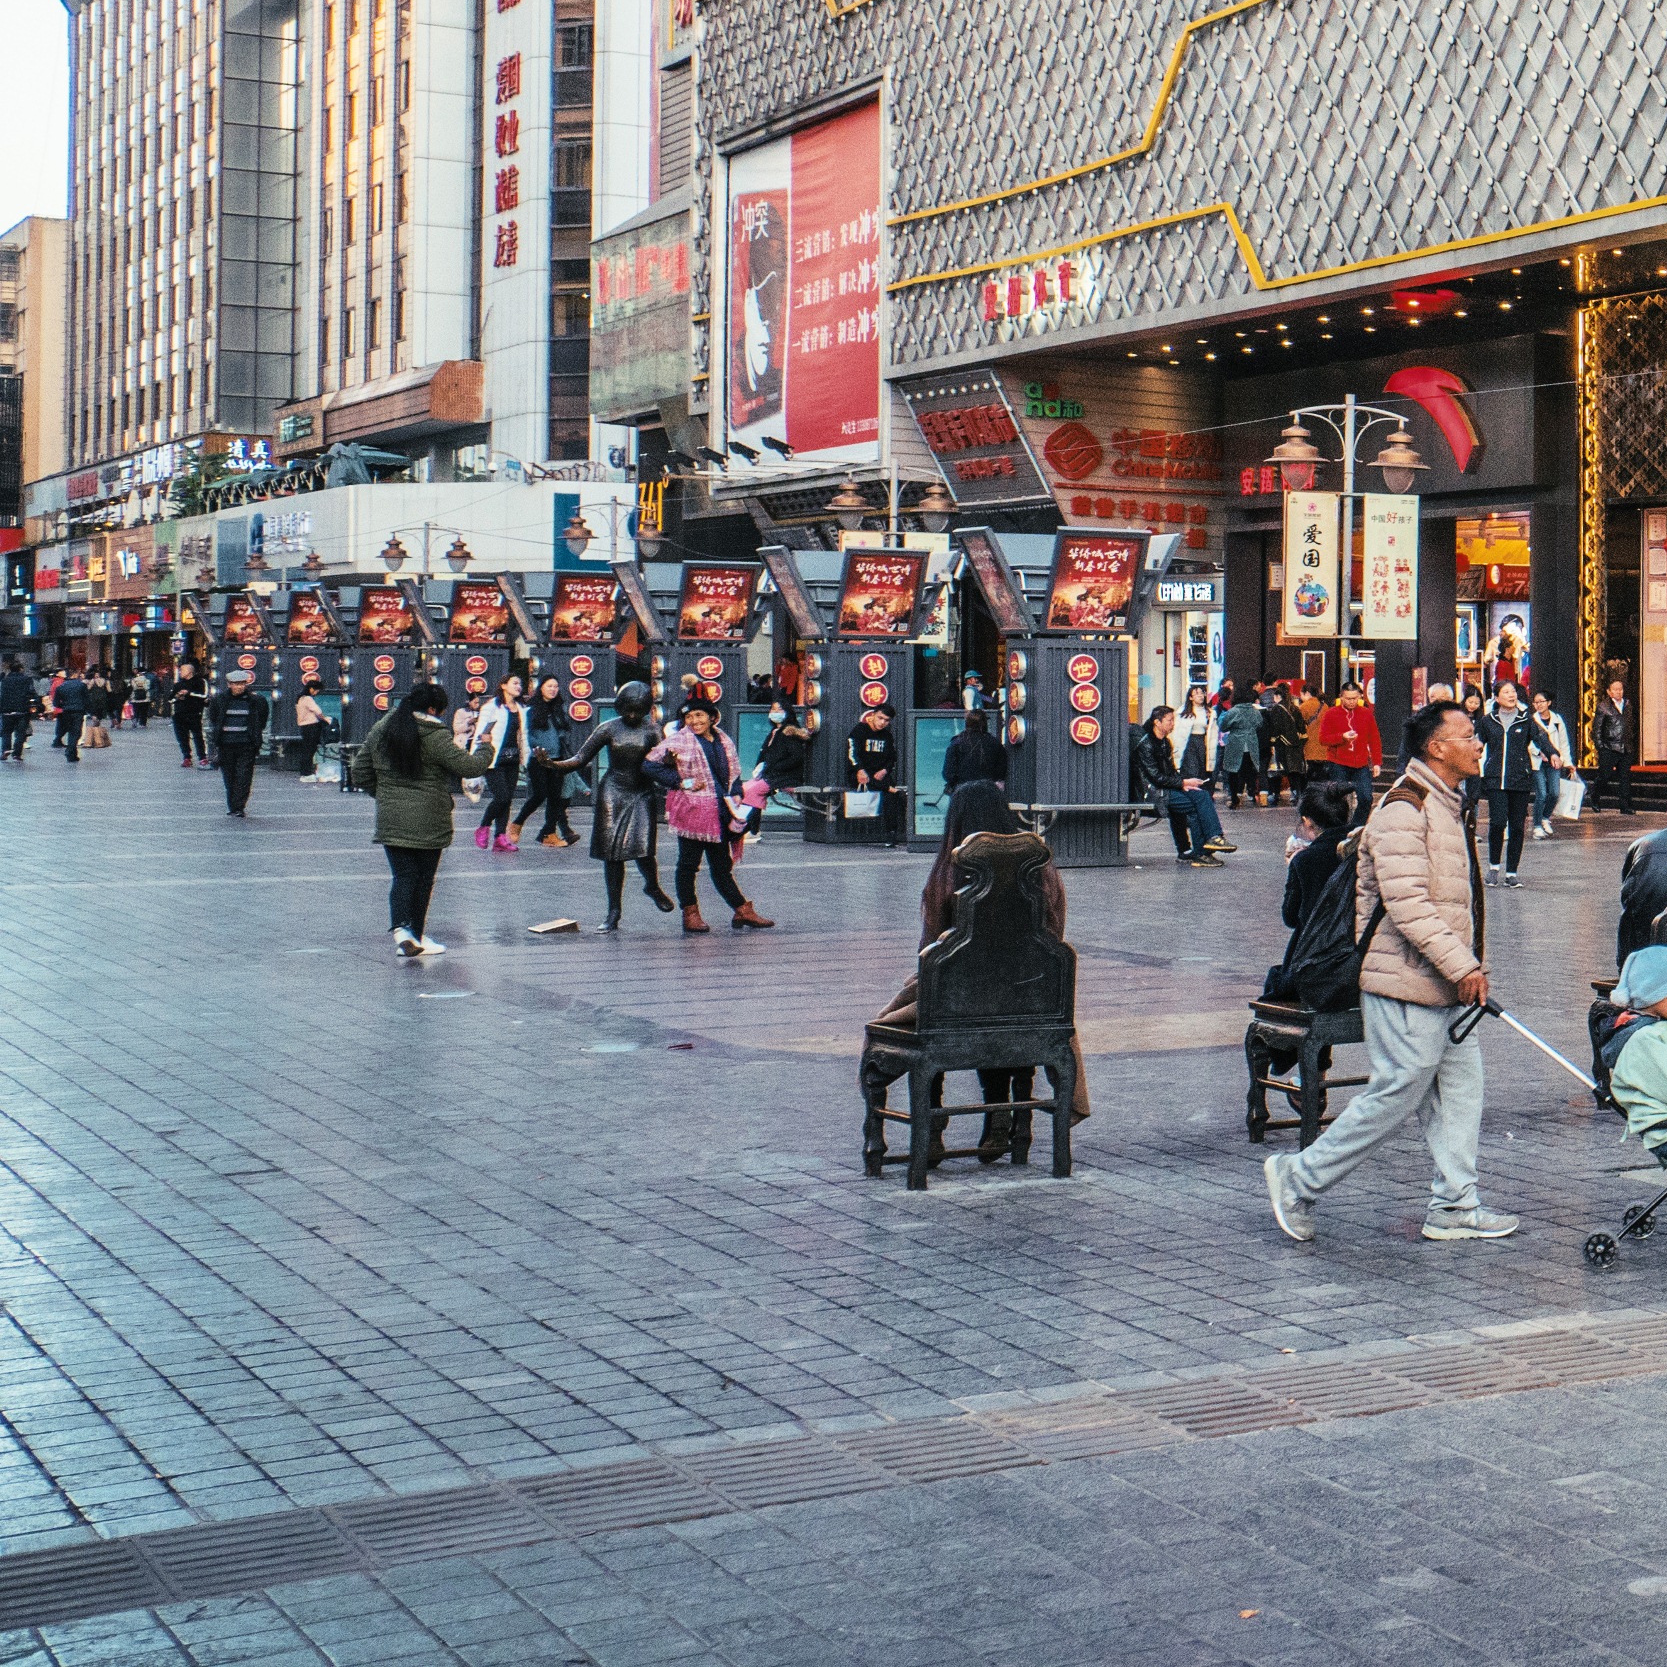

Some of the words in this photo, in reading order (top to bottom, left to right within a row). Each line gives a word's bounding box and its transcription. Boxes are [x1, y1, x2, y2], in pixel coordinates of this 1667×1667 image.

[741, 201, 769, 242] 冲突
[1302, 523, 1323, 568] 爱国
[1072, 661, 1098, 738] 世博园
[865, 739, 886, 752] STAFF
